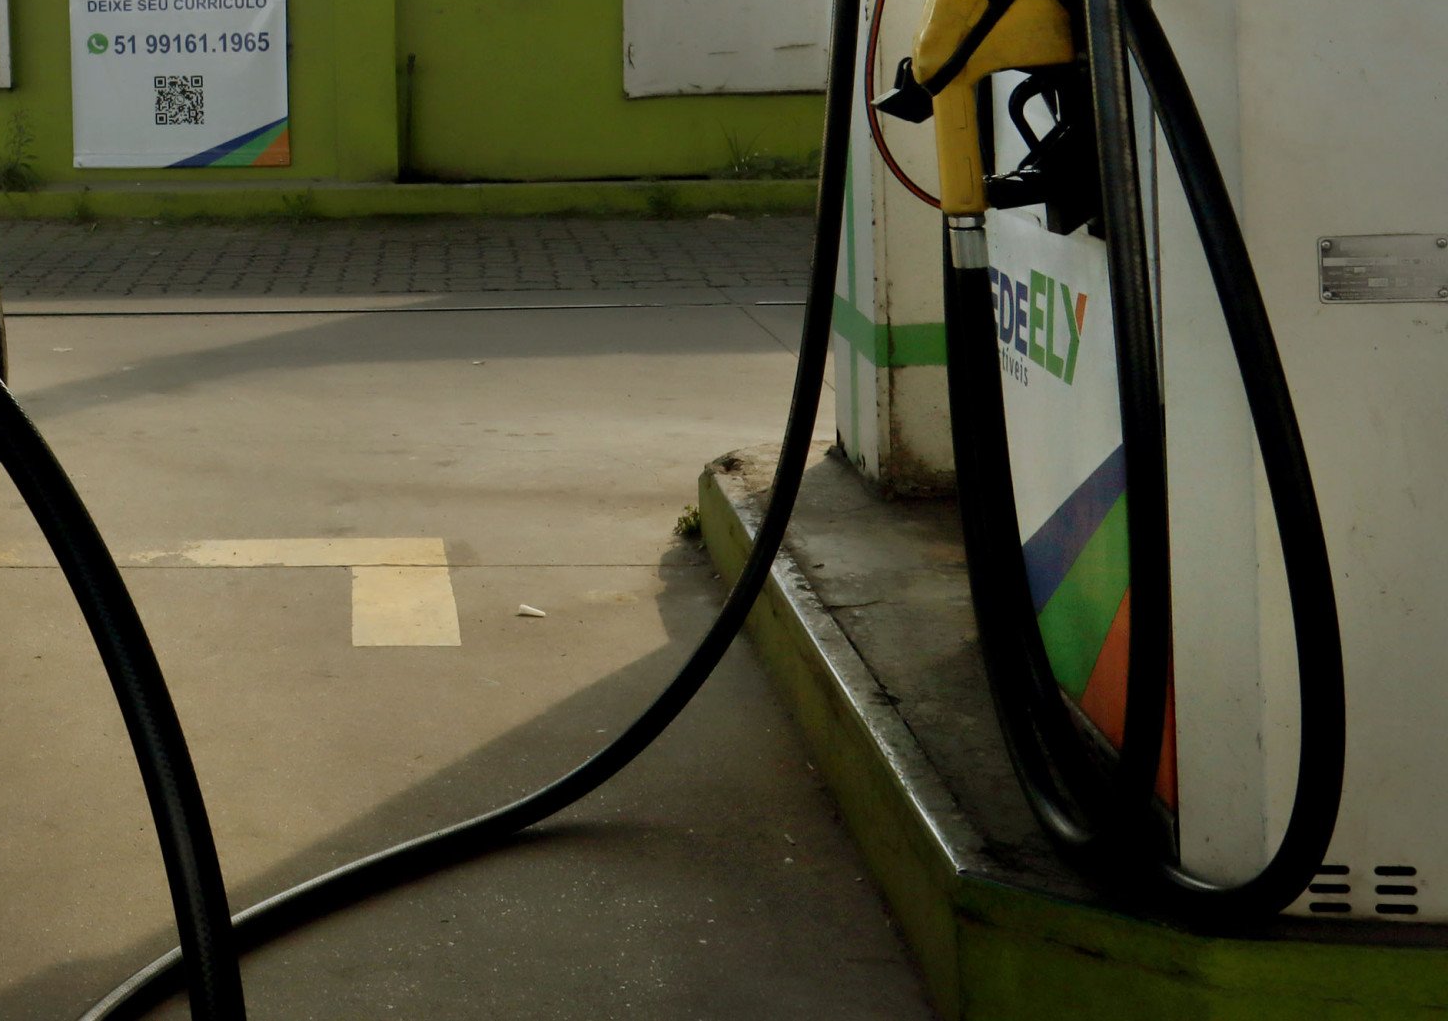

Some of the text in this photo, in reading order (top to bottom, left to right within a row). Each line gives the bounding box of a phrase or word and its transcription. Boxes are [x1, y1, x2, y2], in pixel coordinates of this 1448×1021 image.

[87, 0, 132, 13] DEIXE
[138, 0, 168, 11] SEU
[114, 32, 270, 55] 51 99161.1965
